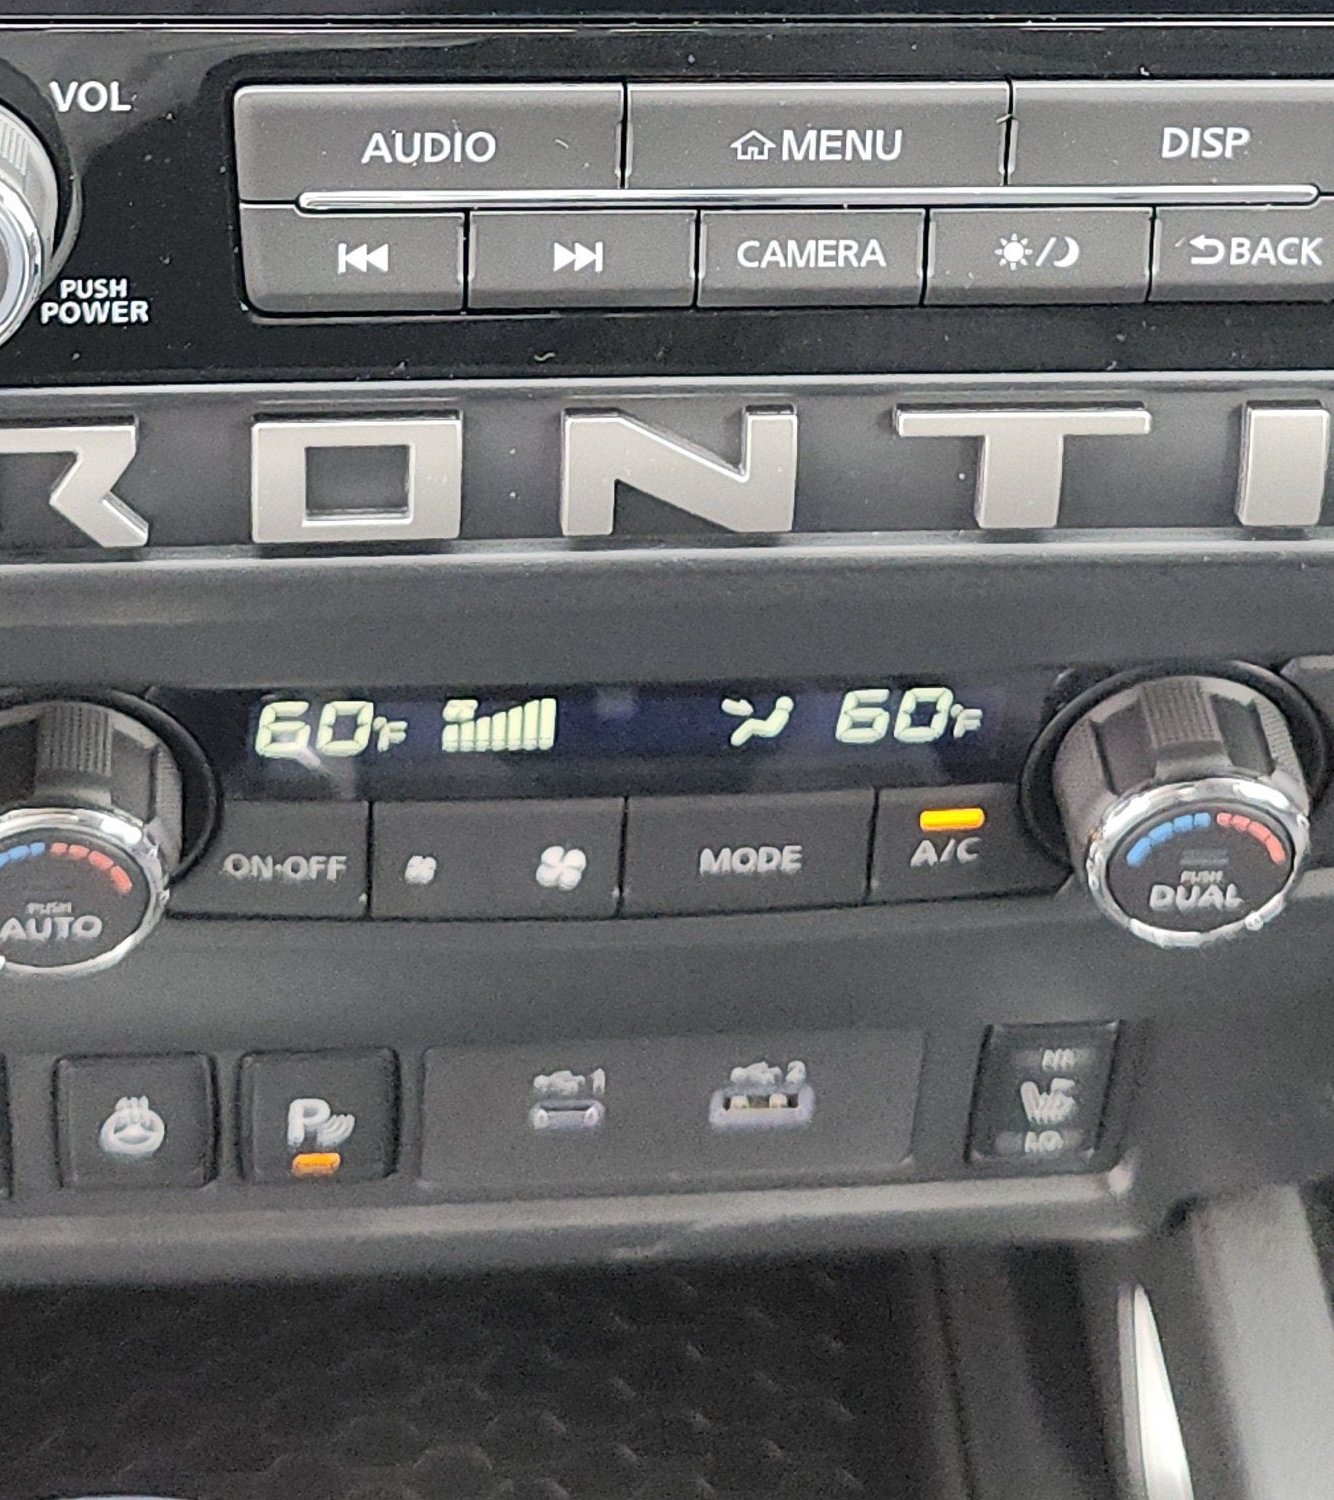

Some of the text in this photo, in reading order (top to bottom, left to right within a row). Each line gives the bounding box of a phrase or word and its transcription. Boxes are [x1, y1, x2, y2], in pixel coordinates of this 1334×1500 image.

[49, 79, 132, 113] VOL
[360, 130, 498, 166] AUDIO
[780, 128, 904, 162] MENU
[1160, 125, 1251, 159] DISP
[736, 239, 888, 270] CAMERA
[1228, 236, 1323, 267] BACK
[59, 277, 129, 299] PUSH
[39, 299, 150, 325] POWER
[699, 844, 803, 877] MODE
[910, 836, 983, 869] A/C
[1148, 882, 1246, 912] DUAL
